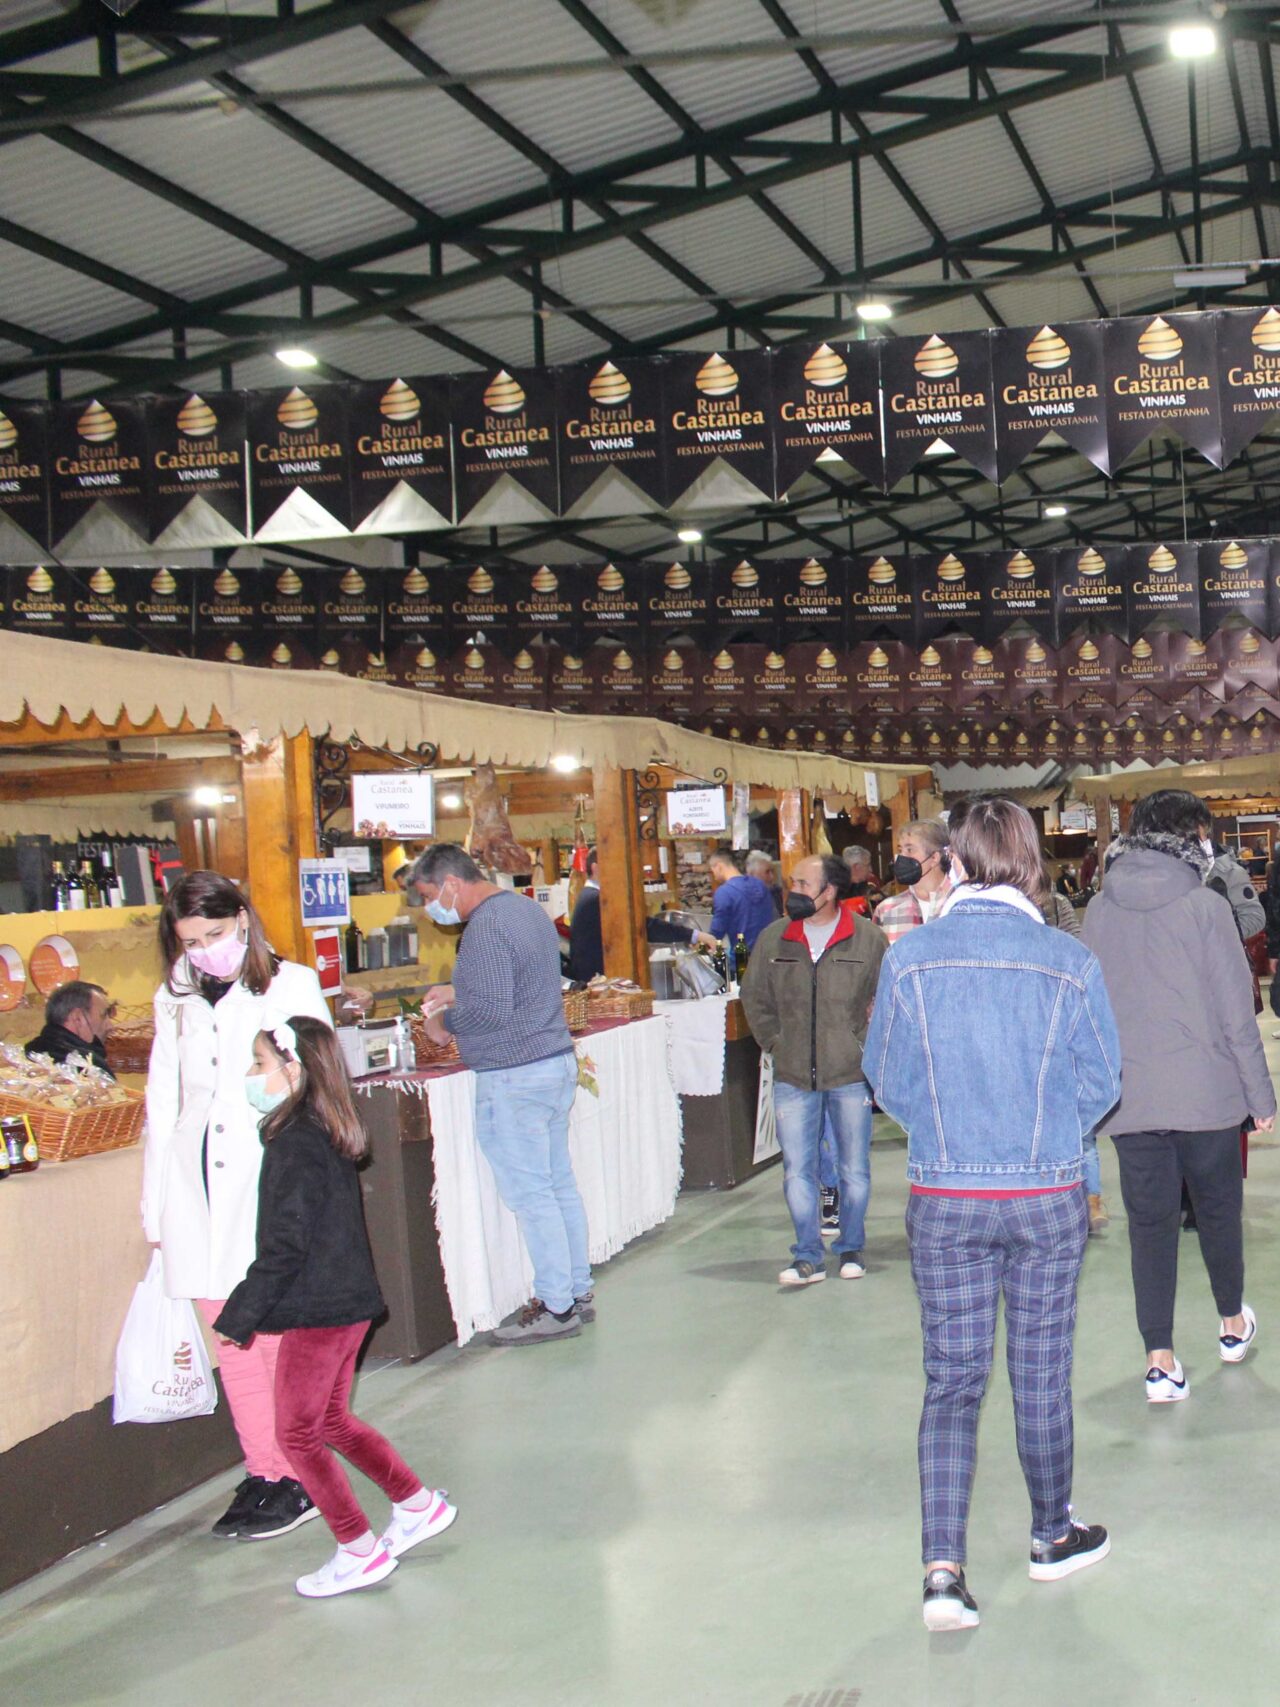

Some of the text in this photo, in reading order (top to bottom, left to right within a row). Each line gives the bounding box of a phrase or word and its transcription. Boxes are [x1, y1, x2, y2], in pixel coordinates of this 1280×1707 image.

[1139, 360, 1184, 378] Rural
[1028, 368, 1072, 387] Rural
[1113, 375, 1210, 394] Castanea
[916, 377, 960, 395] Rural
[1002, 382, 1098, 404] Castanea
[805, 386, 848, 404] Rural
[891, 391, 985, 412] Castanea
[1139, 394, 1185, 407] VINHAIS
[696, 395, 740, 413] Rural
[781, 400, 873, 421] Castanea
[1028, 402, 1074, 416] VINHAIS
[1233, 402, 1259, 412] FESTA
[1261, 401, 1276, 410] DA
[590, 403, 632, 422] Rural
[672, 409, 764, 430] Castanea
[916, 411, 962, 424] VINHAIS
[1118, 407, 1209, 420] FESTA DA CASTANHA
[485, 412, 526, 430] Rural
[566, 418, 656, 438] Castanea
[805, 420, 850, 433] VINHAIS
[1008, 415, 1098, 430] FESTA DA CASTANHA
[381, 420, 421, 438] Rural
[696, 429, 741, 442] VINHAIS
[896, 423, 985, 438] FESTA DA CASTANHA
[278, 428, 318, 446] Rural
[461, 426, 550, 447] Castanea
[589, 437, 633, 450] VINHAIS
[785, 432, 873, 446] FESTA DA CASTANHA
[78, 441, 118, 458] Rural
[178, 435, 217, 453] Rural
[358, 434, 444, 454] Castanea
[677, 441, 764, 455] FESTA DA CASTANHA
[256, 442, 341, 462] Castanea
[485, 445, 527, 459] VINHAIS
[56, 455, 140, 475] Castanea
[155, 450, 240, 469] Castanea
[381, 453, 422, 466] VINHAIS
[177, 468, 218, 480] VINHAIS
[279, 461, 320, 473] VINHAIS
[78, 474, 119, 486] VINHAIS
[1077, 574, 1106, 586] Rural
[1148, 572, 1177, 583] Rural
[868, 583, 896, 594] Rural
[937, 580, 965, 592] Rural
[1062, 584, 1122, 597] Castanea
[1132, 581, 1193, 594] Castanea
[852, 593, 912, 604] Castanea
[921, 590, 981, 602] Castanea
[1077, 596, 1107, 605] VINHAIS
[1148, 594, 1178, 602] VINHAIS
[867, 605, 897, 613] VINHAIS
[936, 602, 966, 610] VINHAIS
